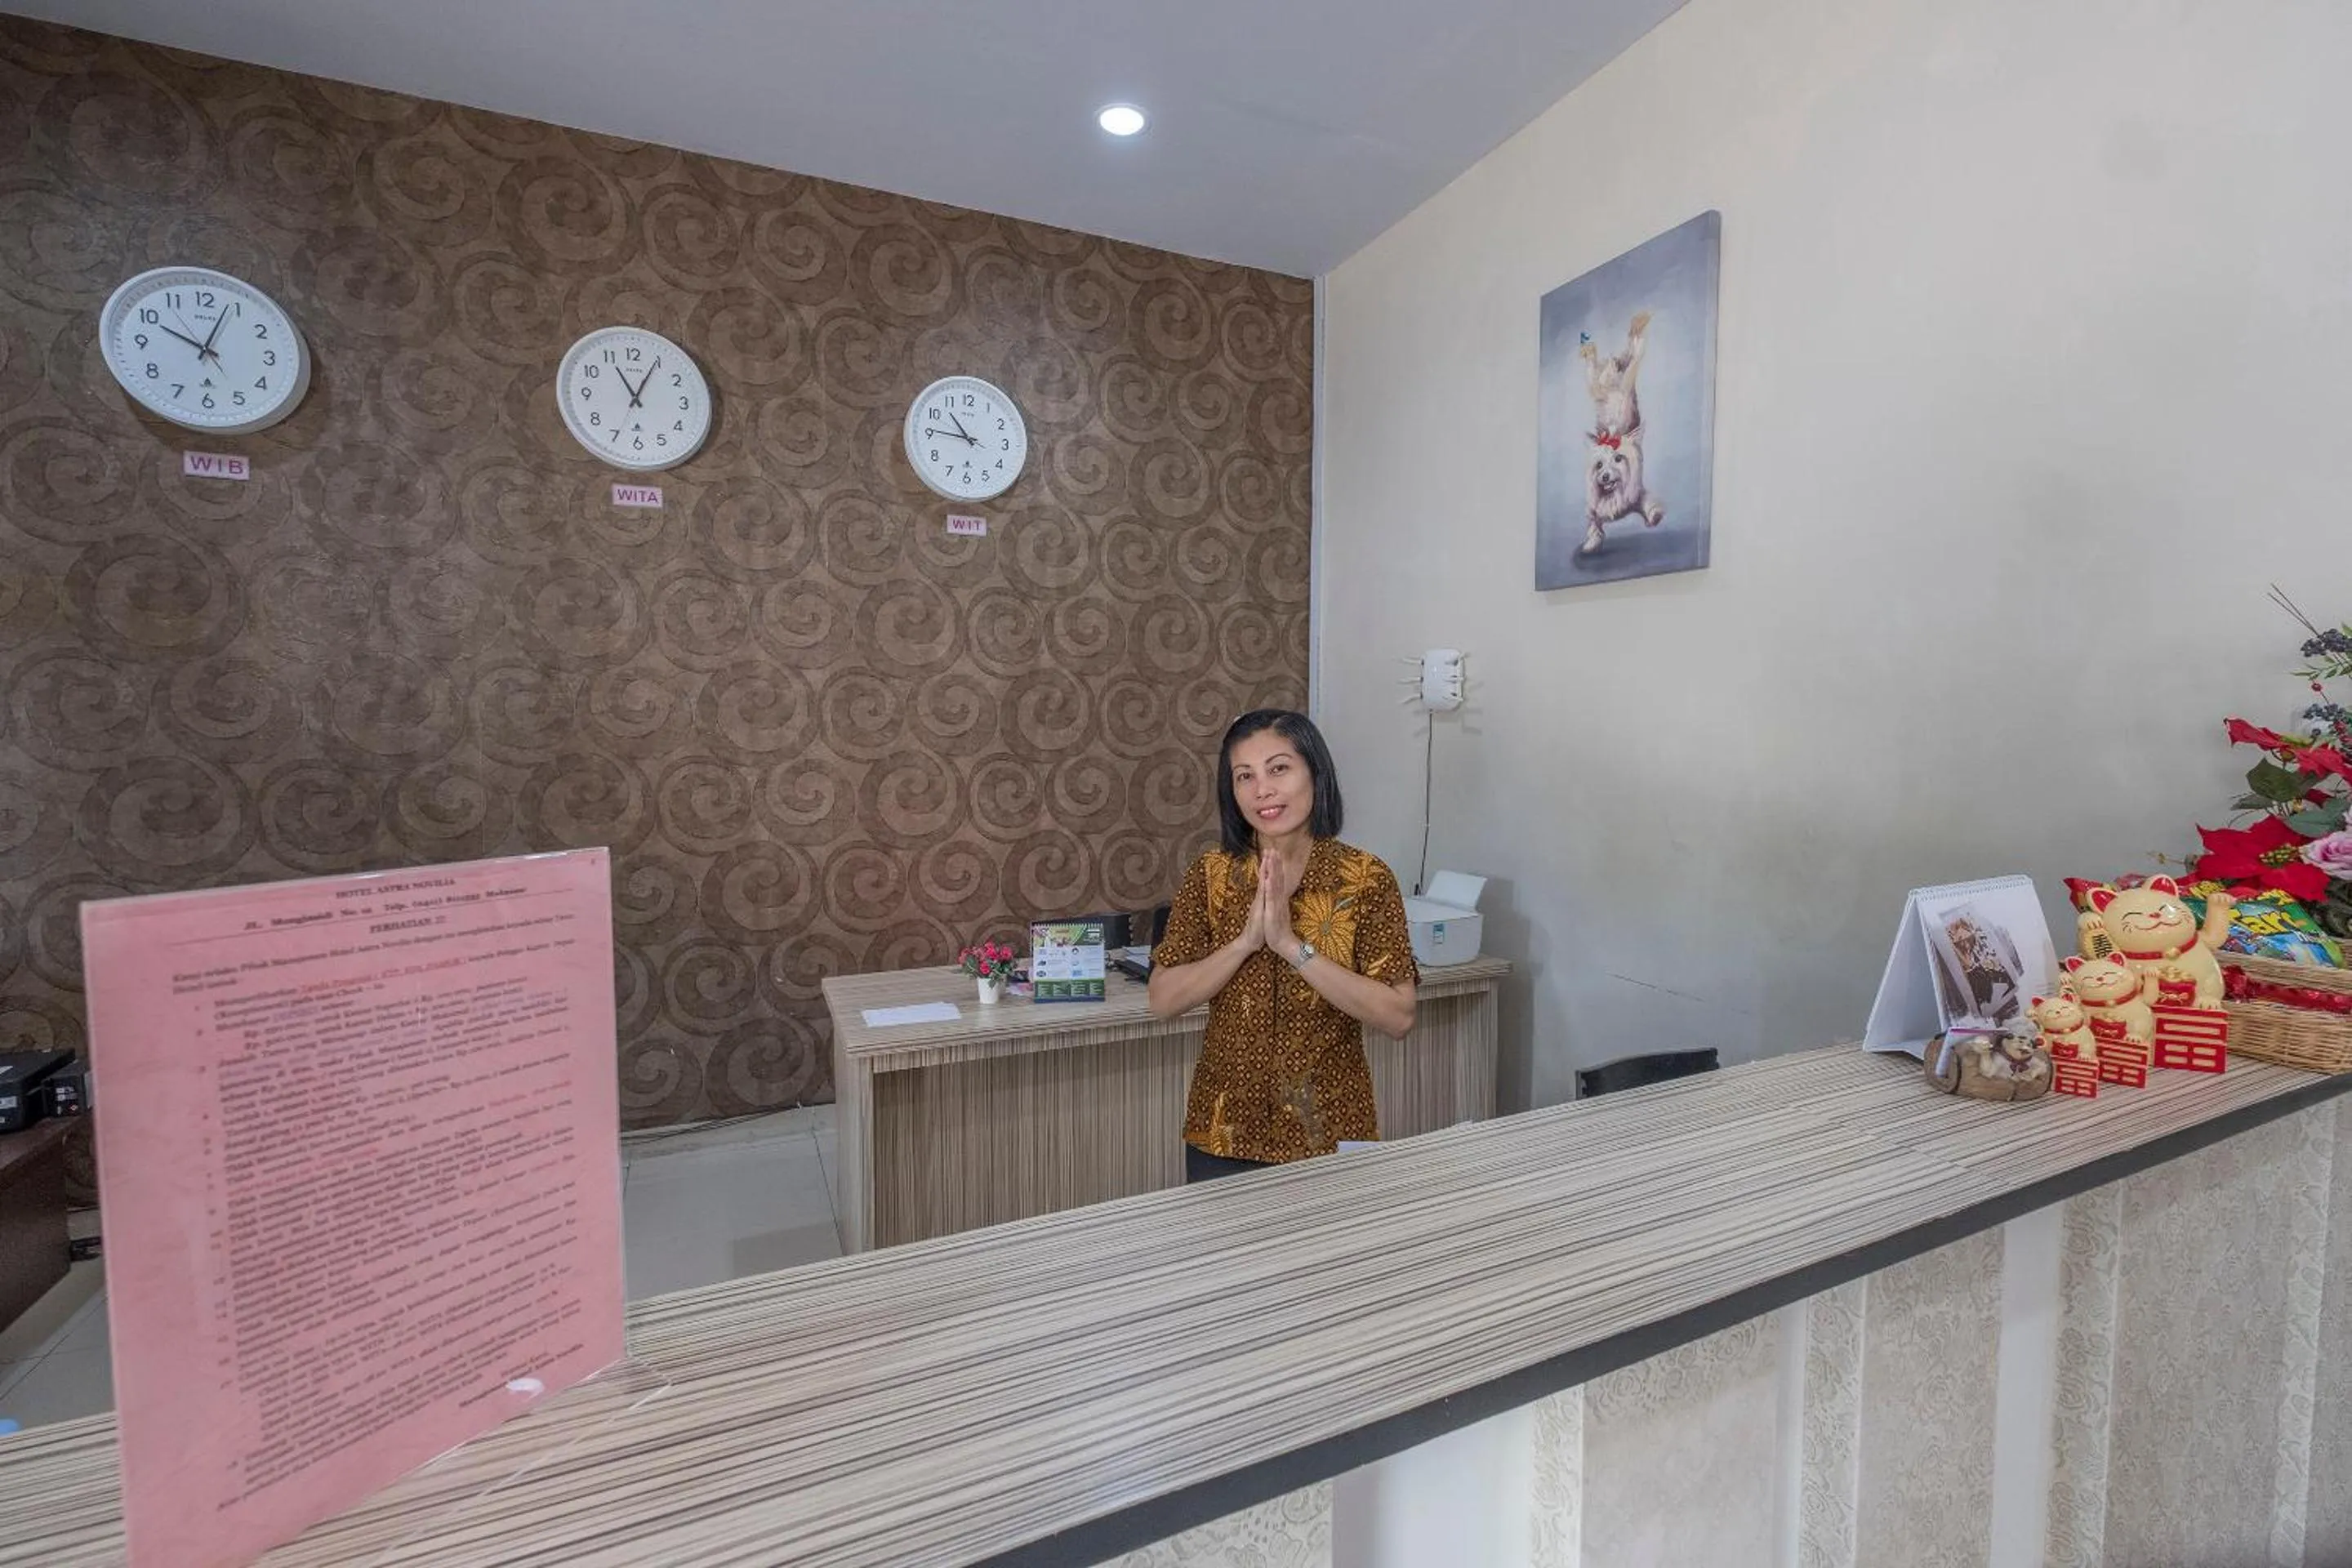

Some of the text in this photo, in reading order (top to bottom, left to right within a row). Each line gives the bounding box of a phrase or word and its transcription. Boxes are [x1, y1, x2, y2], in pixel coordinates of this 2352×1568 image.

[166, 292, 180, 310] 11
[196, 292, 214, 308] 12
[140, 309, 158, 323] 10
[255, 324, 268, 339] 2
[135, 334, 148, 350] 9
[264, 350, 275, 366] 3
[604, 350, 616, 363] 11
[626, 348, 641, 362] 12
[146, 363, 159, 379] 8
[584, 364, 599, 379] 10
[255, 376, 267, 390] 4
[672, 374, 682, 387] 2
[172, 383, 185, 399] 7
[233, 391, 245, 405] 5
[581, 386, 592, 400] 9
[202, 394, 214, 408] 6
[679, 396, 689, 410] 3
[945, 396, 955, 408] 11
[963, 394, 974, 407] 12
[590, 412, 601, 425] 8
[929, 408, 941, 421] 10
[674, 420, 684, 431] 4
[996, 418, 1004, 430] 2
[609, 429, 620, 443] 7
[657, 434, 667, 446] 5
[924, 427, 934, 439] 9
[633, 436, 644, 450] 6
[1001, 439, 1009, 450] 3
[930, 450, 938, 461] 8
[189, 456, 243, 474] WIB
[995, 458, 1003, 470] 4
[946, 466, 954, 477] 7
[962, 472, 971, 484] 6
[982, 470, 991, 482] 5
[617, 489, 659, 504] WITA
[953, 519, 982, 531] WIT
